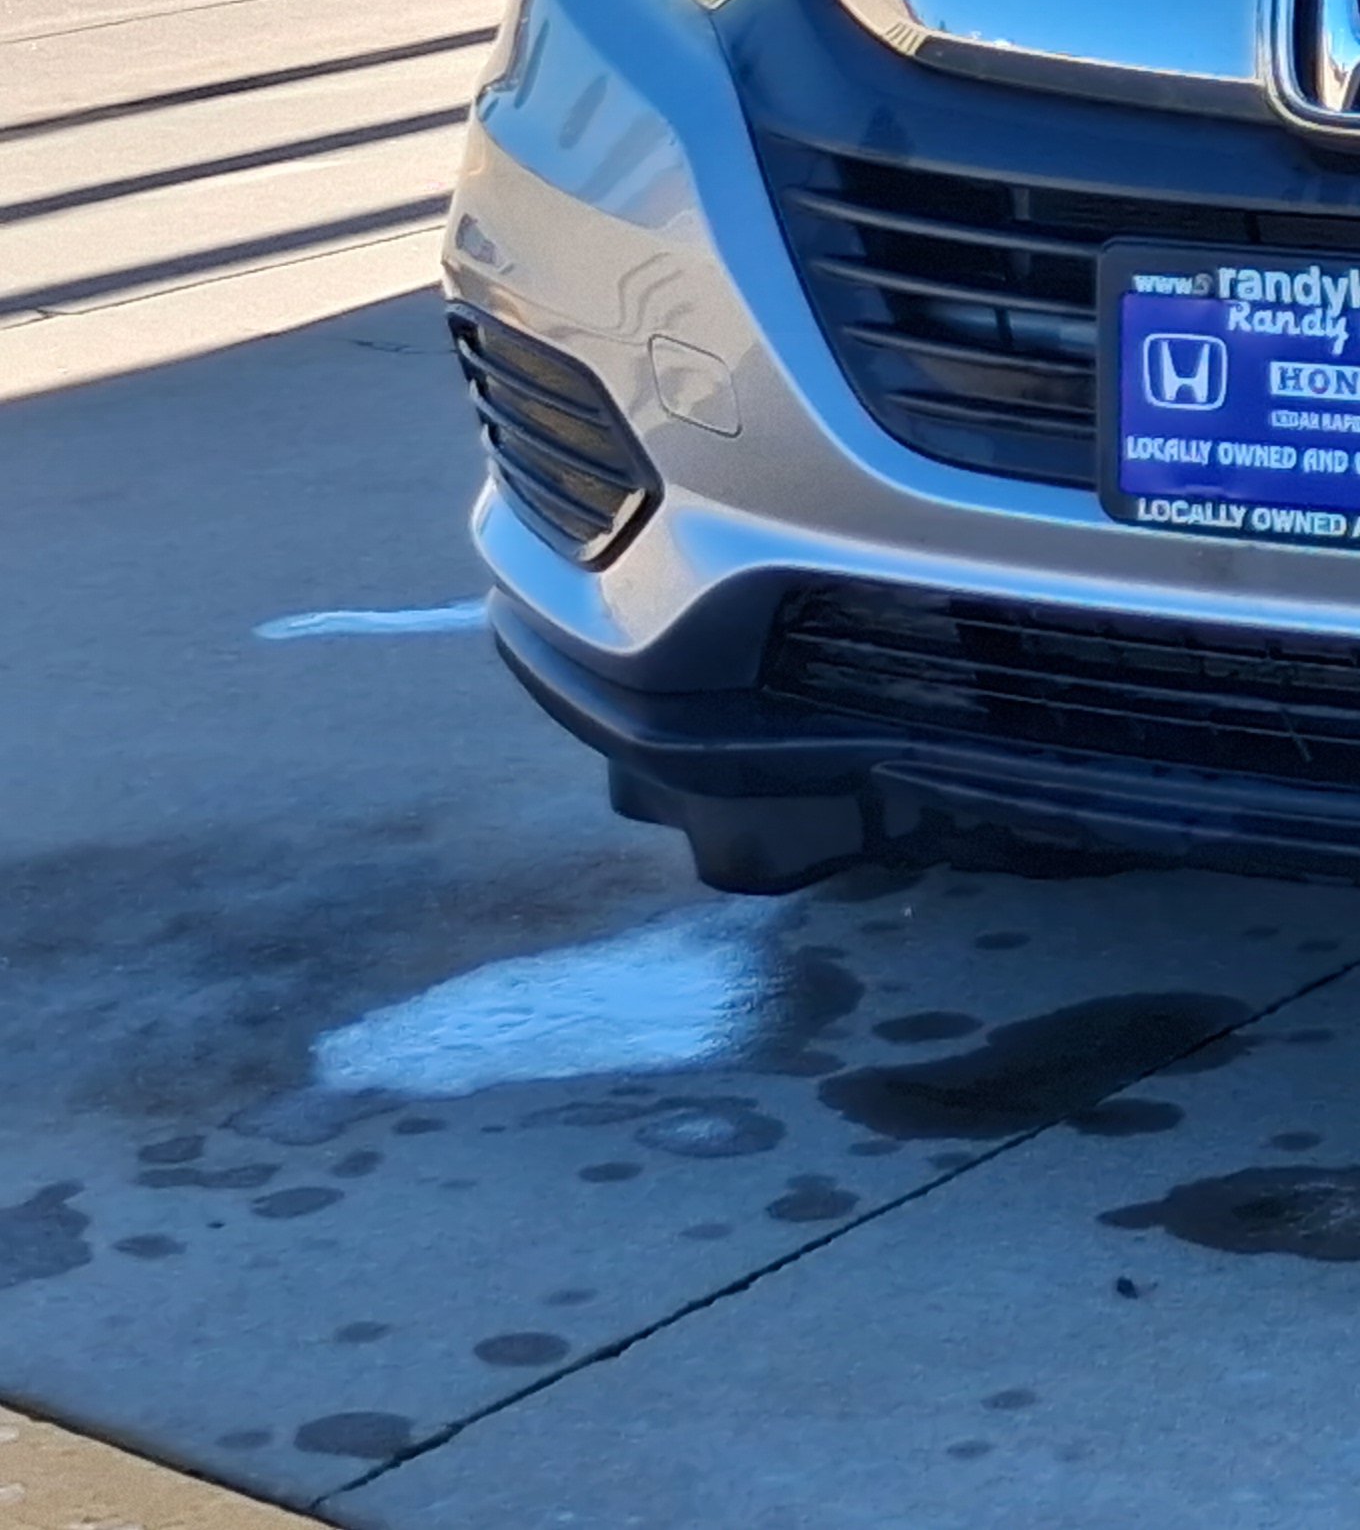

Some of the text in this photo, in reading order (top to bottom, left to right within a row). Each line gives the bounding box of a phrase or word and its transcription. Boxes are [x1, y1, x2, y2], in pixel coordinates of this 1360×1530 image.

[1227, 301, 1349, 355] Randy
[1126, 435, 1213, 466] LOCALLY
[1217, 442, 1297, 469] OWNED
[1302, 448, 1349, 474] AND
[1137, 497, 1247, 529] LOCALLY
[1252, 508, 1347, 536] OWNED
